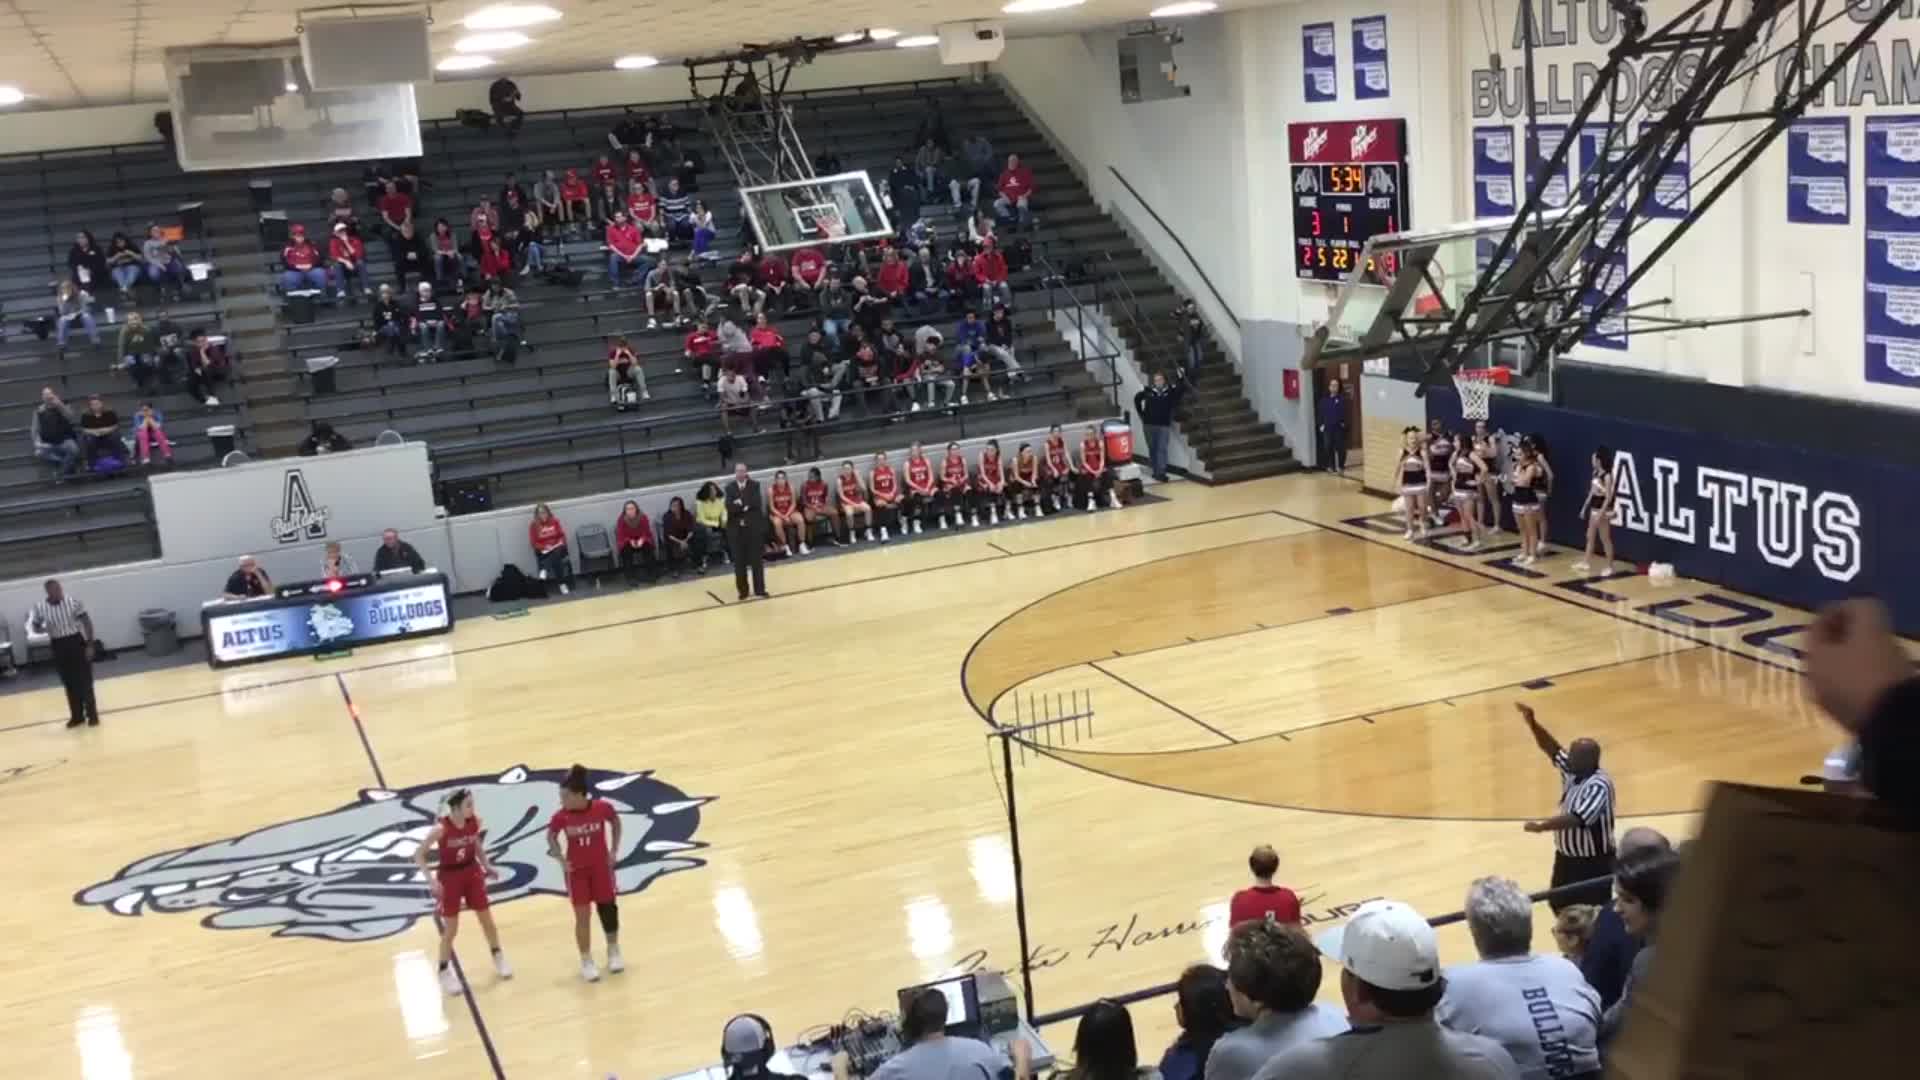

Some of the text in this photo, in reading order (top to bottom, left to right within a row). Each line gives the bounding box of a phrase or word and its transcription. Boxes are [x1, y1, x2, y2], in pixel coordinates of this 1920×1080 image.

[1331, 166, 1361, 192] 5:34
[1311, 210, 1321, 235] 3
[281, 469, 326, 543] A
[1610, 450, 1861, 583] ALTUS
[368, 599, 444, 625] BULLDOGS
[222, 624, 284, 649] ALTUS
